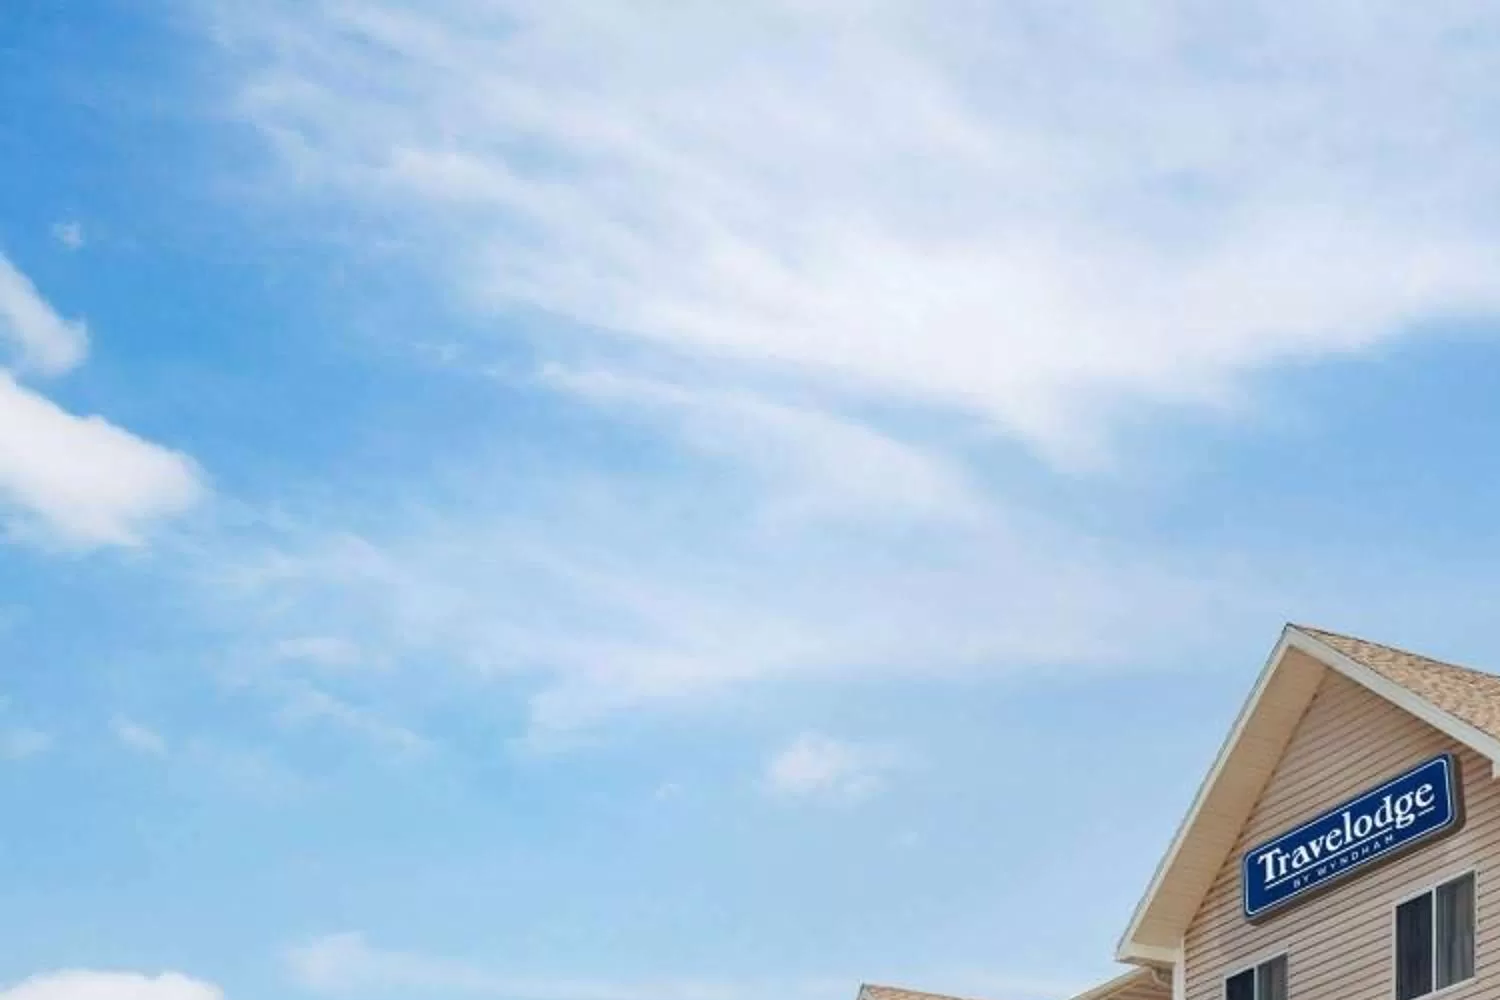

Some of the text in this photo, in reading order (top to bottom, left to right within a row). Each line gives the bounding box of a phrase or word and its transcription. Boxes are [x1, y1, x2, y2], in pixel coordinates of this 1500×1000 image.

[1257, 783, 1435, 883] Travelodge
[1293, 834, 1394, 889] BY WYNDHAM
